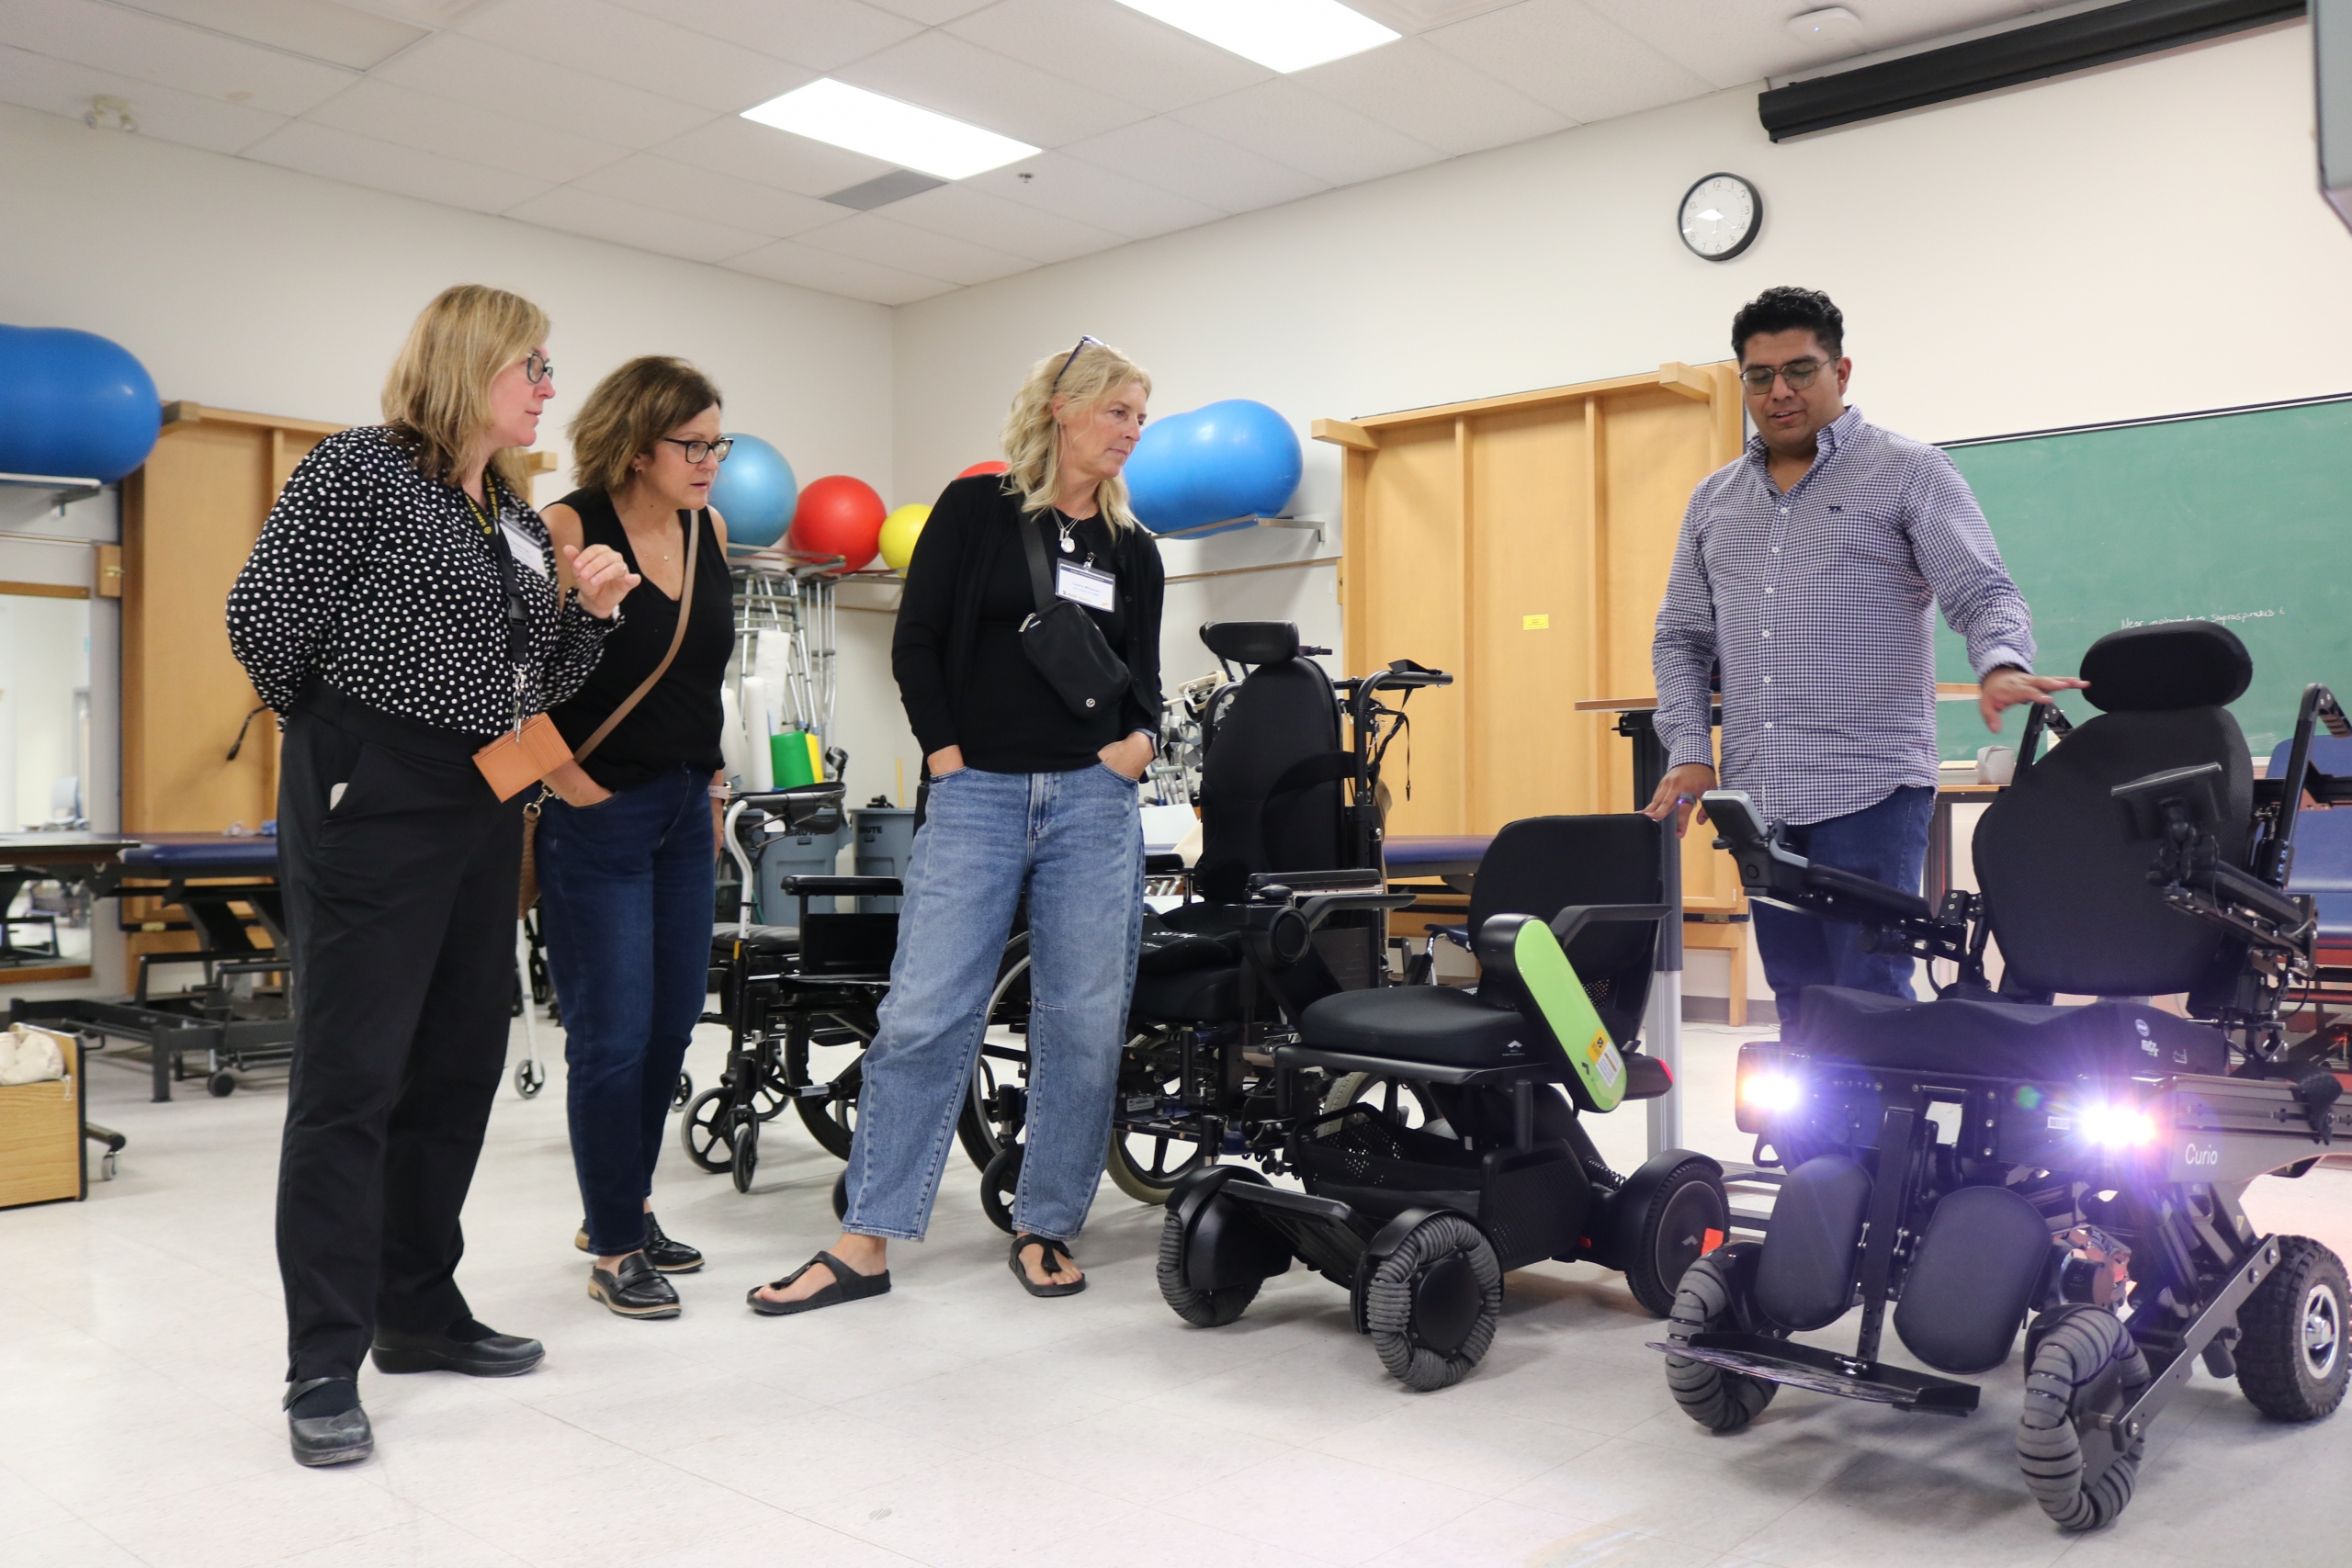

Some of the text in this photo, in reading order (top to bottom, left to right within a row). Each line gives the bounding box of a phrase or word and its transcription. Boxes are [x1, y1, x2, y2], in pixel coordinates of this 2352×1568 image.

[1713, 180, 1722, 188] 12
[1731, 181, 1735, 189] 1
[1699, 187, 1705, 196] 11
[1688, 201, 1696, 209] 10
[1745, 206, 1749, 214] 3
[1686, 217, 1691, 225] 9
[1739, 221, 1746, 230] 4
[1690, 232, 1695, 241] 8
[1731, 236, 1736, 245] 5
[1702, 243, 1707, 251] 7
[1714, 243, 1722, 252] 6
[475, 513, 487, 526] 2025
[2185, 1143, 2218, 1165] Curio
